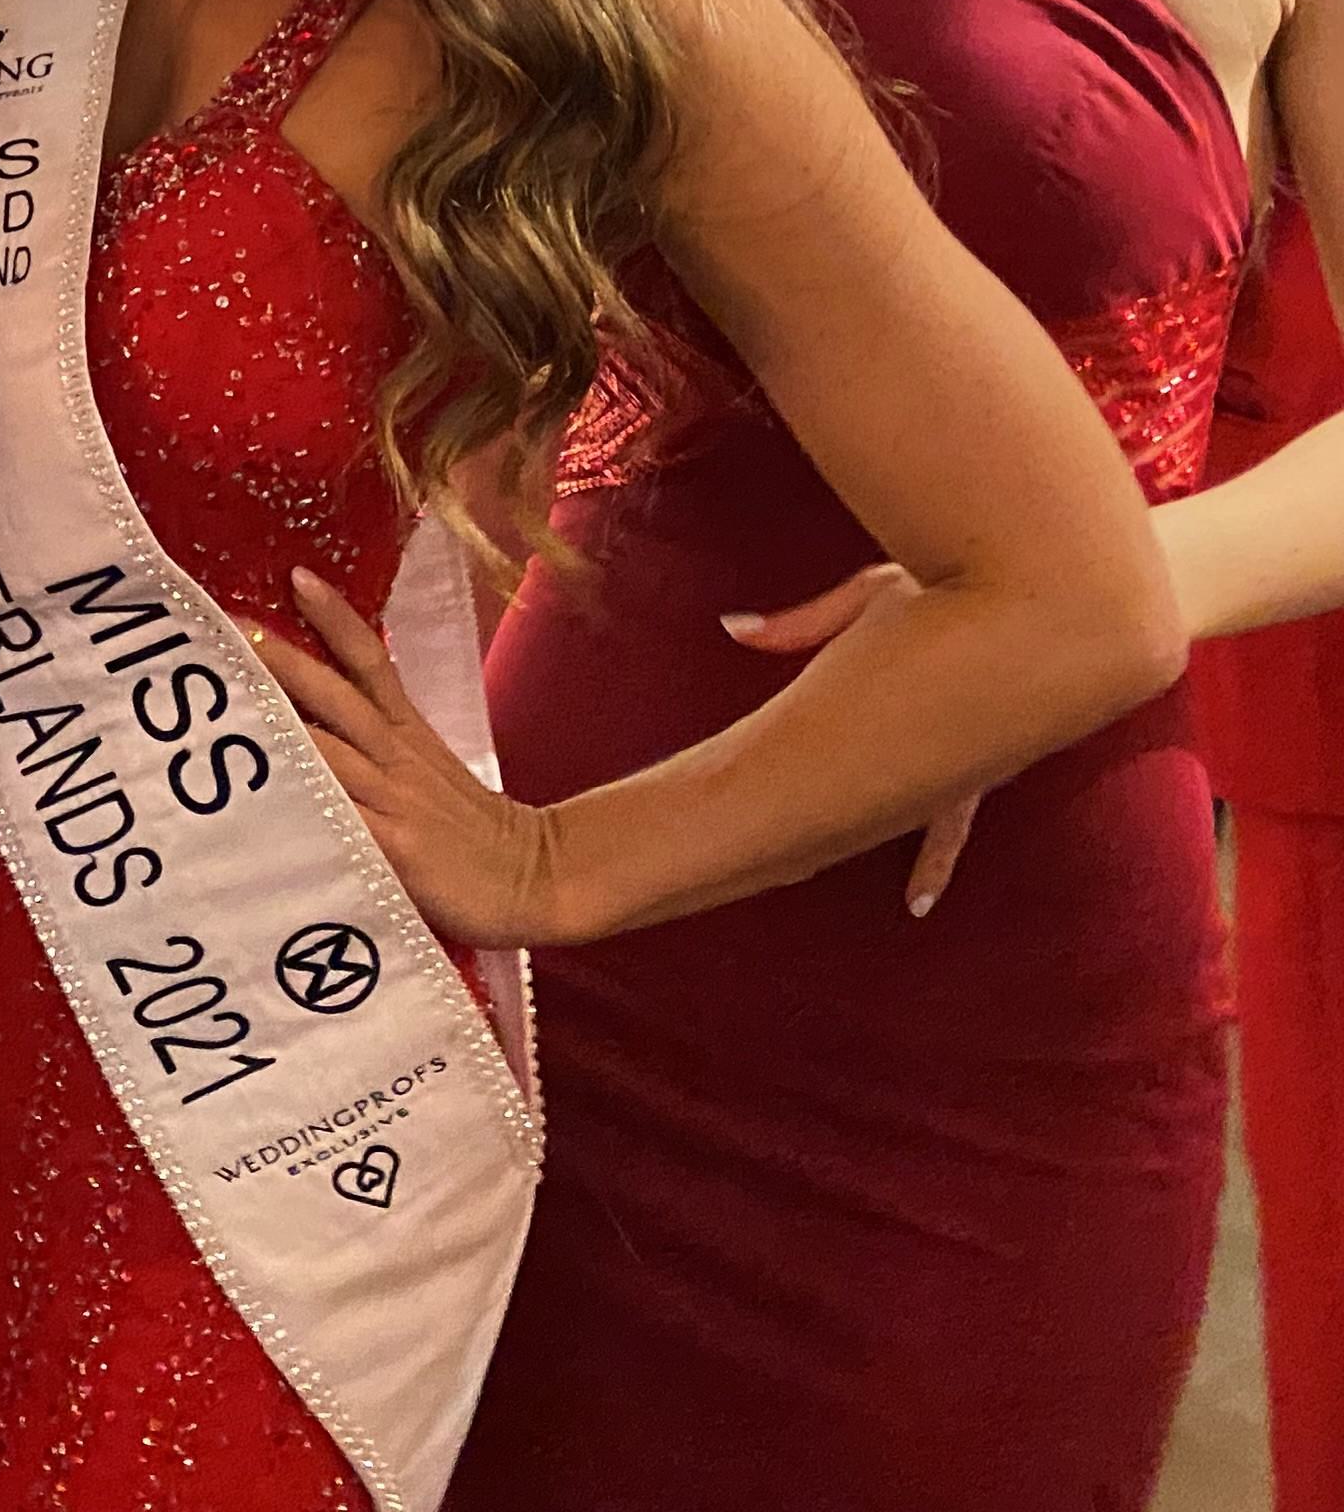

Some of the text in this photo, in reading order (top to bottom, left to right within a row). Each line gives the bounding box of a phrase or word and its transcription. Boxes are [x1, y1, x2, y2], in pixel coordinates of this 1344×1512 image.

[44, 565, 270, 815] MISS
[105, 936, 276, 1105] 2021
[213, 1056, 448, 1183] WEDDINGPROFS
[287, 1107, 409, 1176] EXCLUSIVE
